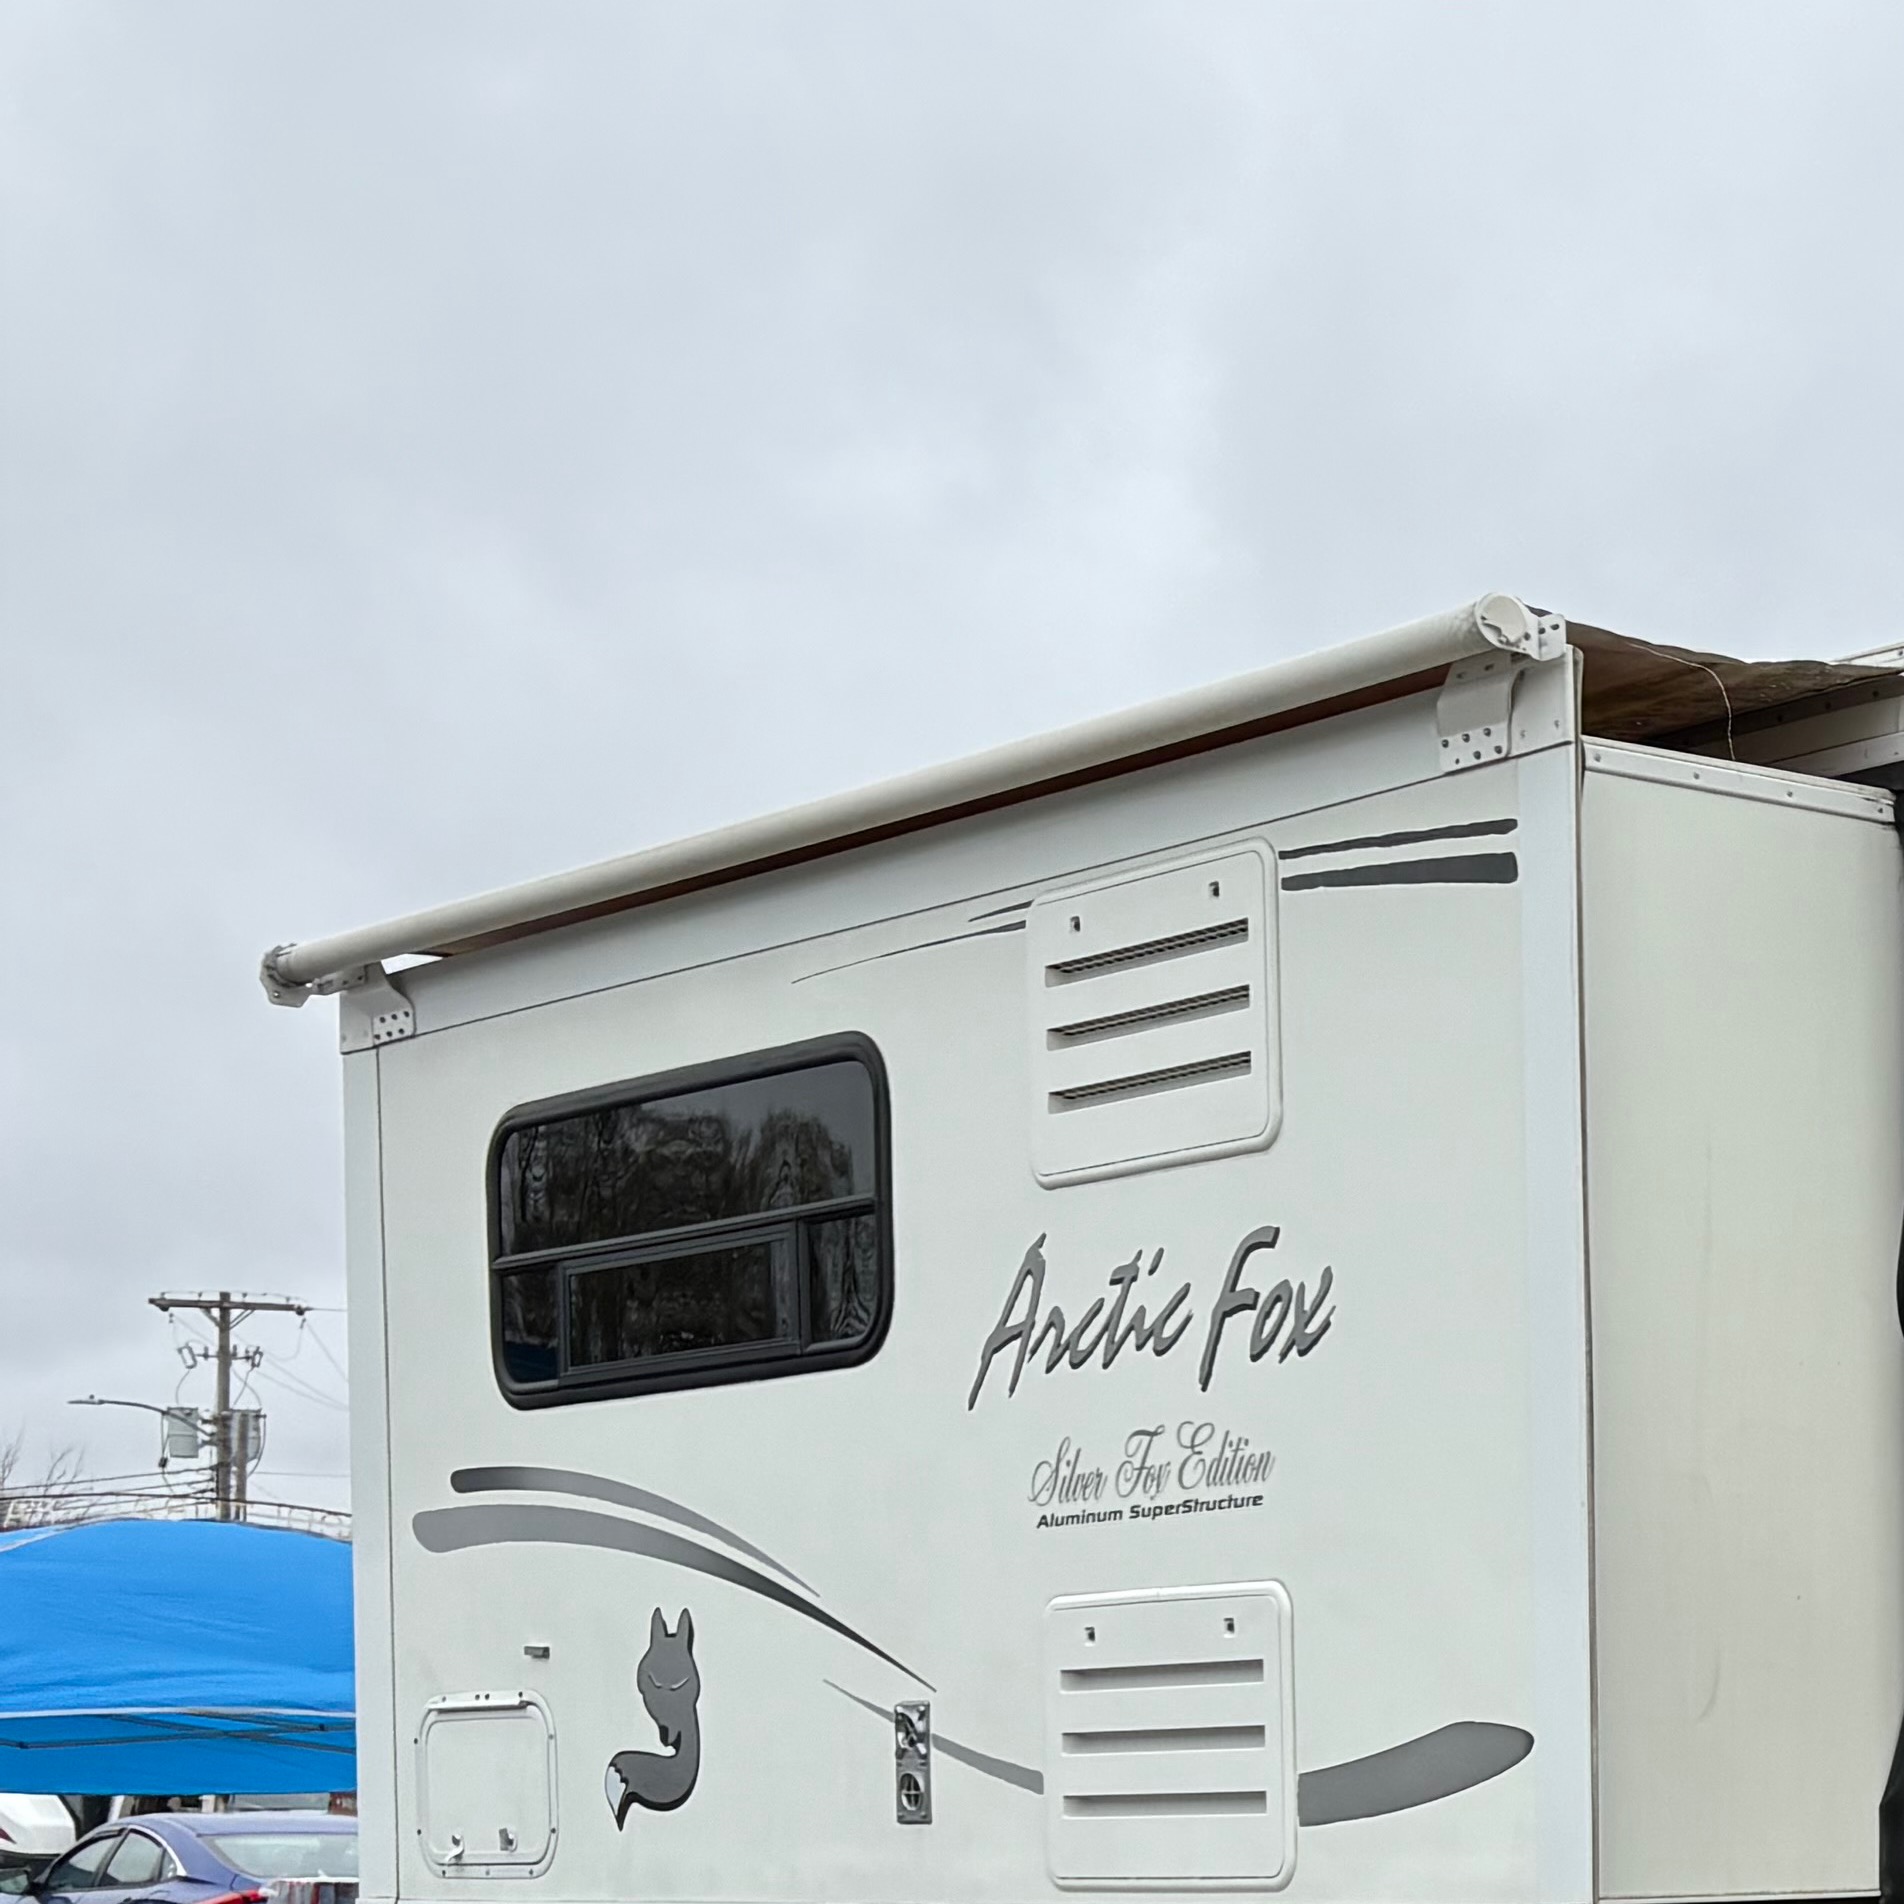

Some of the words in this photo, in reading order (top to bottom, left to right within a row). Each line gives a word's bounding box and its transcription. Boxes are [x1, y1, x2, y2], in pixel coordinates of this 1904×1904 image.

[967, 1231, 1194, 1411] Arctic
[1198, 1225, 1336, 1392] Fox
[1027, 1436, 1108, 1506] Silver
[1115, 1424, 1172, 1500] Fox
[1176, 1420, 1276, 1490] Edition
[1036, 1508, 1123, 1529] Aluminum
[1129, 1494, 1264, 1520] SuperStructure
